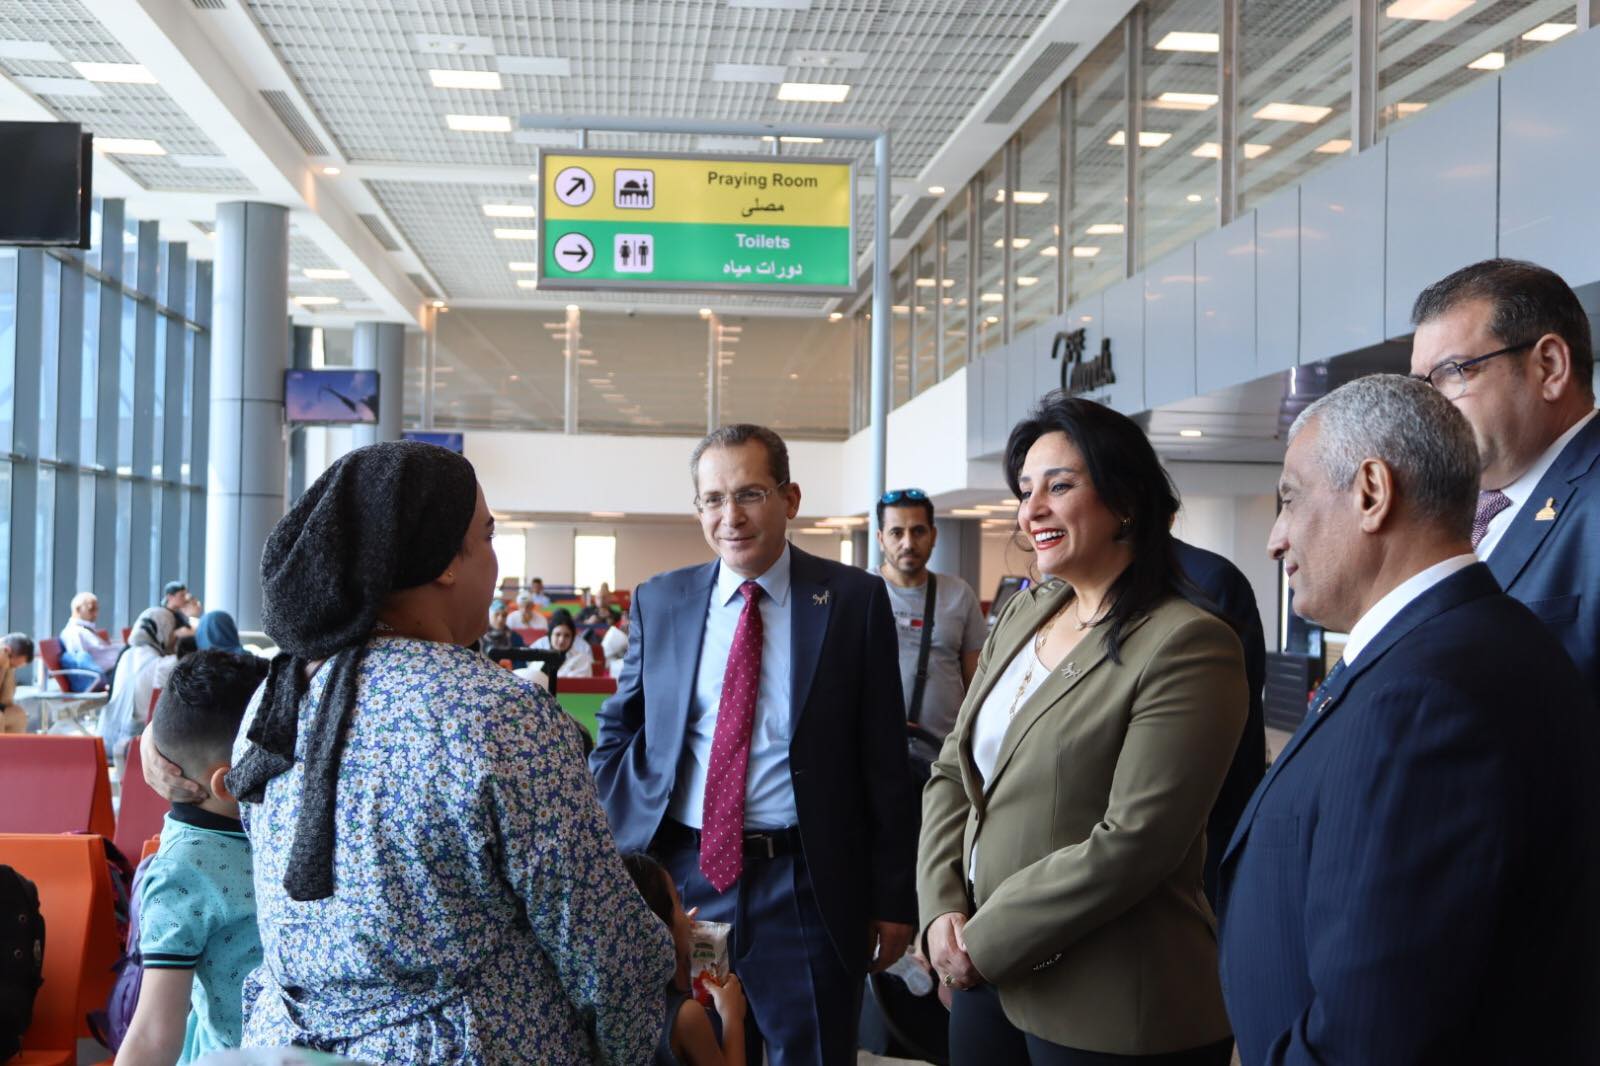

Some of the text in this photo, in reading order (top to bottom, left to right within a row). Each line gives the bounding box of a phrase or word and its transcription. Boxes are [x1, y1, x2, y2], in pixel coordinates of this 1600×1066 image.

[708, 171, 818, 189] Praying Room
[736, 233, 790, 249] Toilets
[723, 260, 802, 278] دورات مياه
